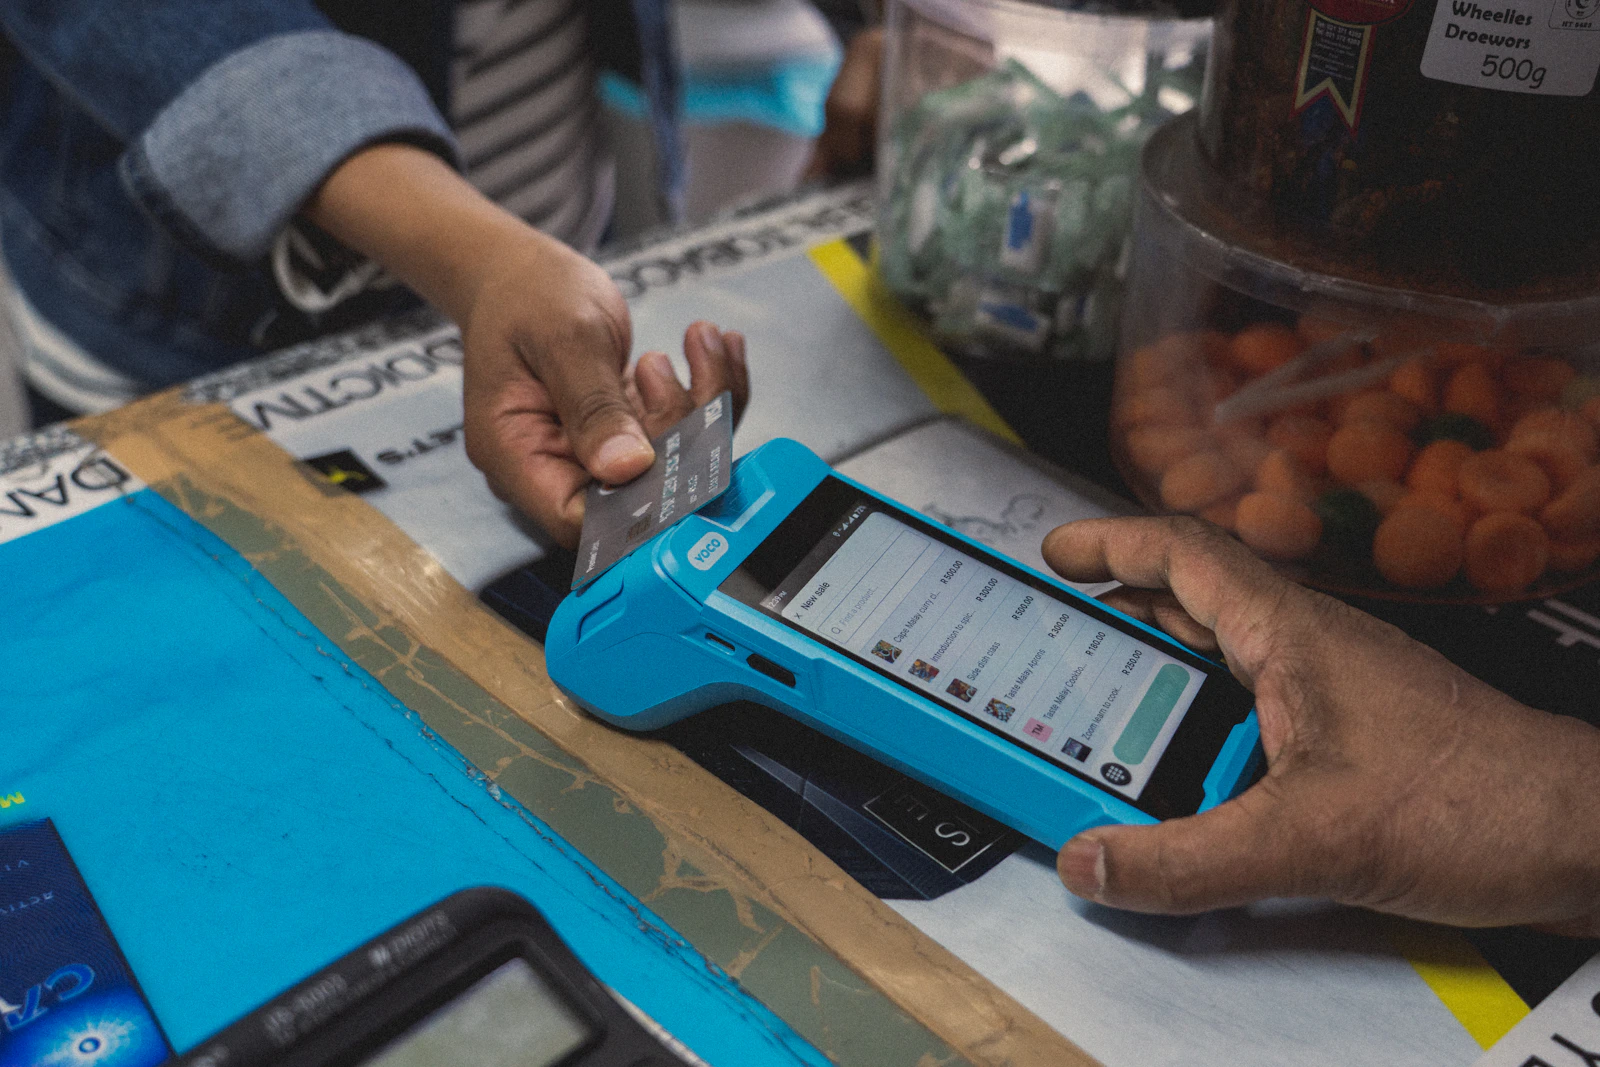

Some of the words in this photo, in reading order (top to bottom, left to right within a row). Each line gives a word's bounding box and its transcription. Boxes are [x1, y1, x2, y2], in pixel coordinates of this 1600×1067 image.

[1452, 0, 1533, 26] Wheelies
[1445, 23, 1531, 50] Droewors
[1480, 54, 1547, 90] 500g
[694, 538, 721, 563] YOCO
[801, 595, 817, 611] New
[815, 582, 831, 597] sale
[893, 627, 910, 643] Cape
[905, 612, 923, 629] Malay
[919, 598, 935, 613] curry
[930, 629, 960, 662] Introduction
[955, 622, 964, 632] to
[966, 667, 982, 681] Side
[978, 654, 991, 669] dish
[986, 641, 1001, 657] class
[1004, 684, 1021, 700] Taste
[1016, 668, 1033, 685] Malay
[1027, 648, 1046, 669] Aprons
[1043, 704, 1060, 720] Taste
[1054, 687, 1072, 705] Malay
[1031, 723, 1045, 736] TM
[1081, 721, 1098, 741] Zoom
[1094, 707, 1107, 724] learn
[1103, 701, 1112, 709] to
